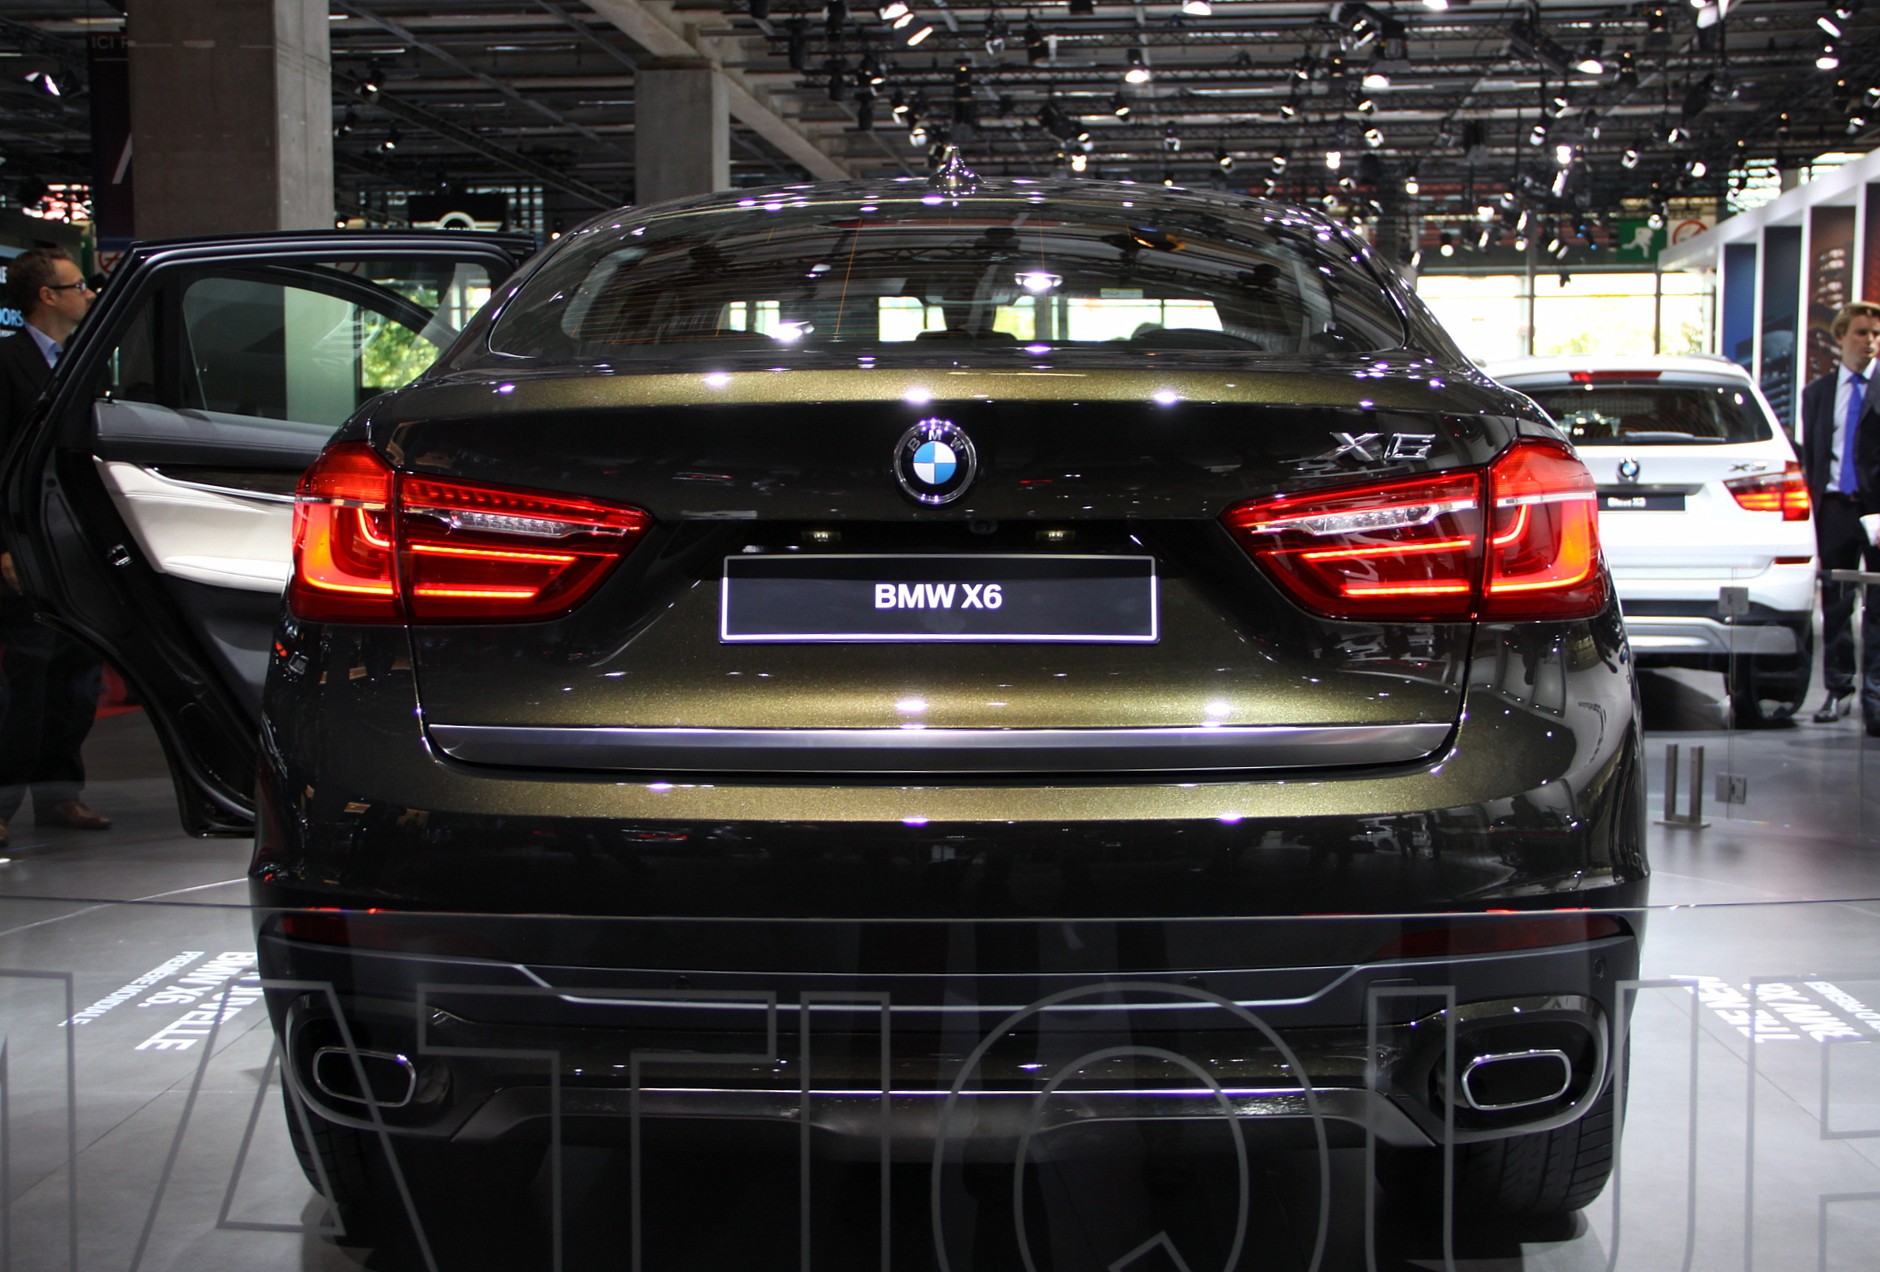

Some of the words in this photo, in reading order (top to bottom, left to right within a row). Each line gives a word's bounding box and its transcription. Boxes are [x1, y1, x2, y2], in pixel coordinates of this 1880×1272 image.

[907, 429, 964, 452] BMW
[874, 583, 957, 609] BMW
[960, 583, 1004, 609] X6
[178, 951, 258, 985] BMW
[135, 971, 264, 1050] UVELLE
